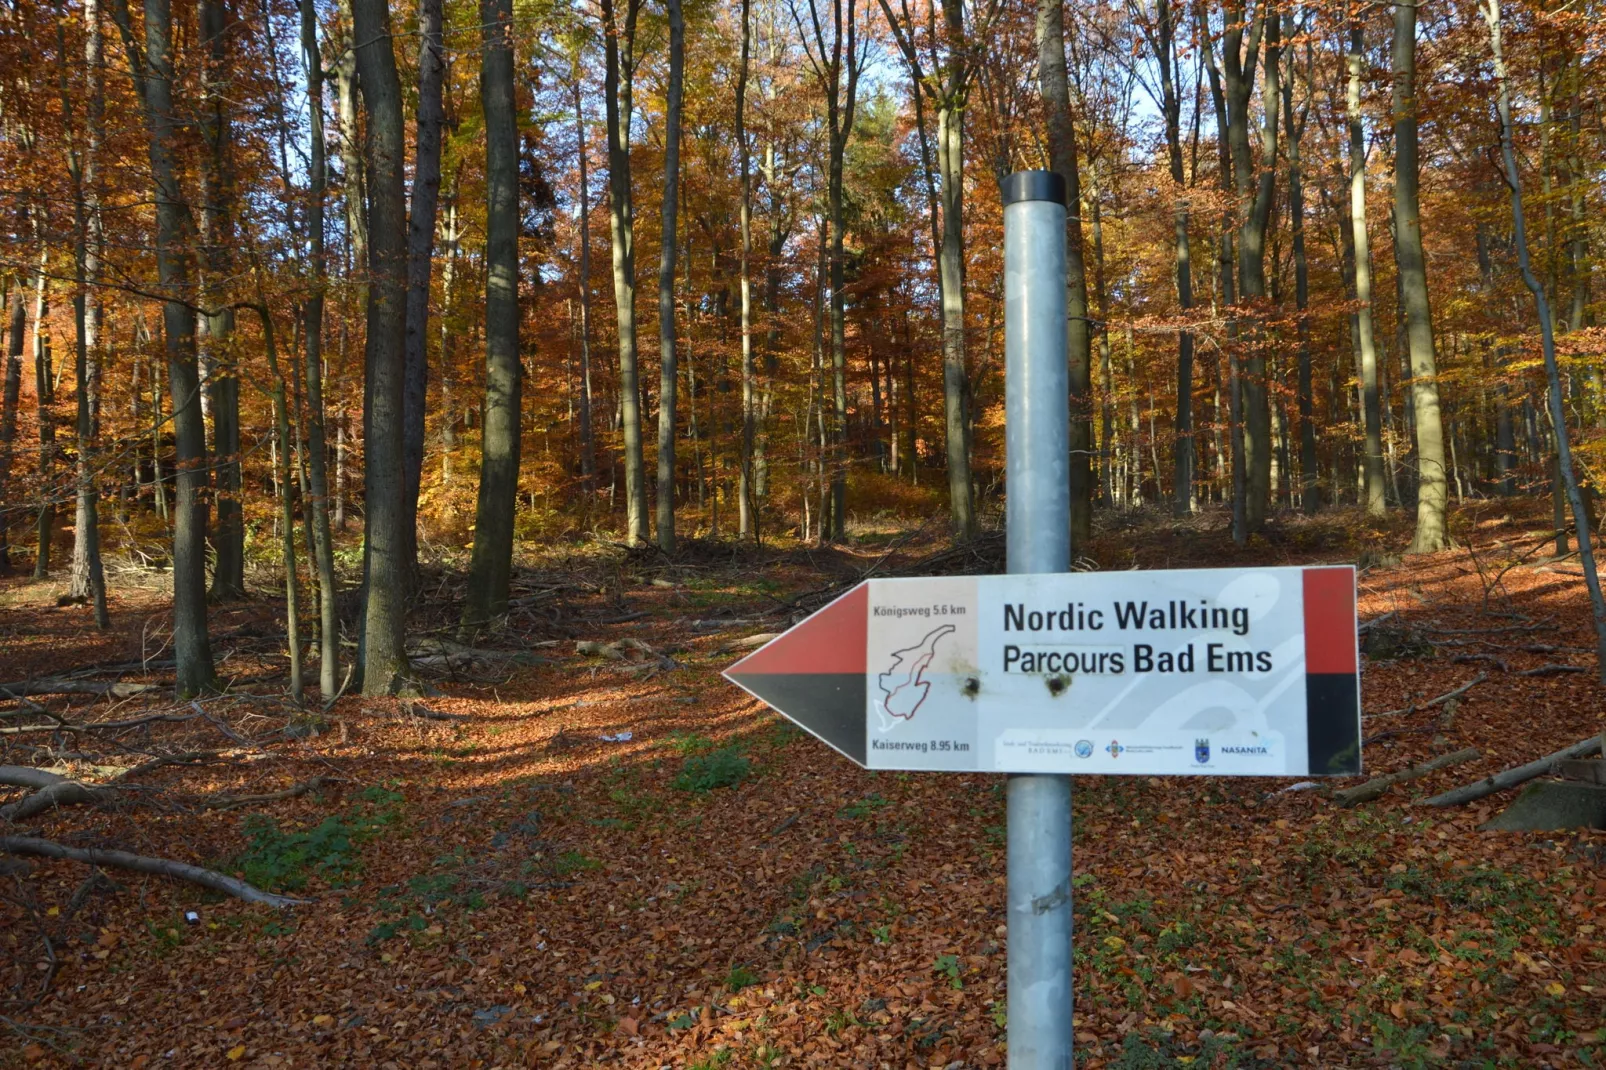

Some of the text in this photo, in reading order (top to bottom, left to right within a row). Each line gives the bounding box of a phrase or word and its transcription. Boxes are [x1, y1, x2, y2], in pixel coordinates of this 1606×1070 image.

[873, 604, 966, 618] Königsweg 5.6 km
[1004, 600, 1249, 636] Nordic Walking
[1003, 643, 1273, 674] Parcours Bad Ems
[872, 739, 969, 753] Kaiserweg 8.95 km
